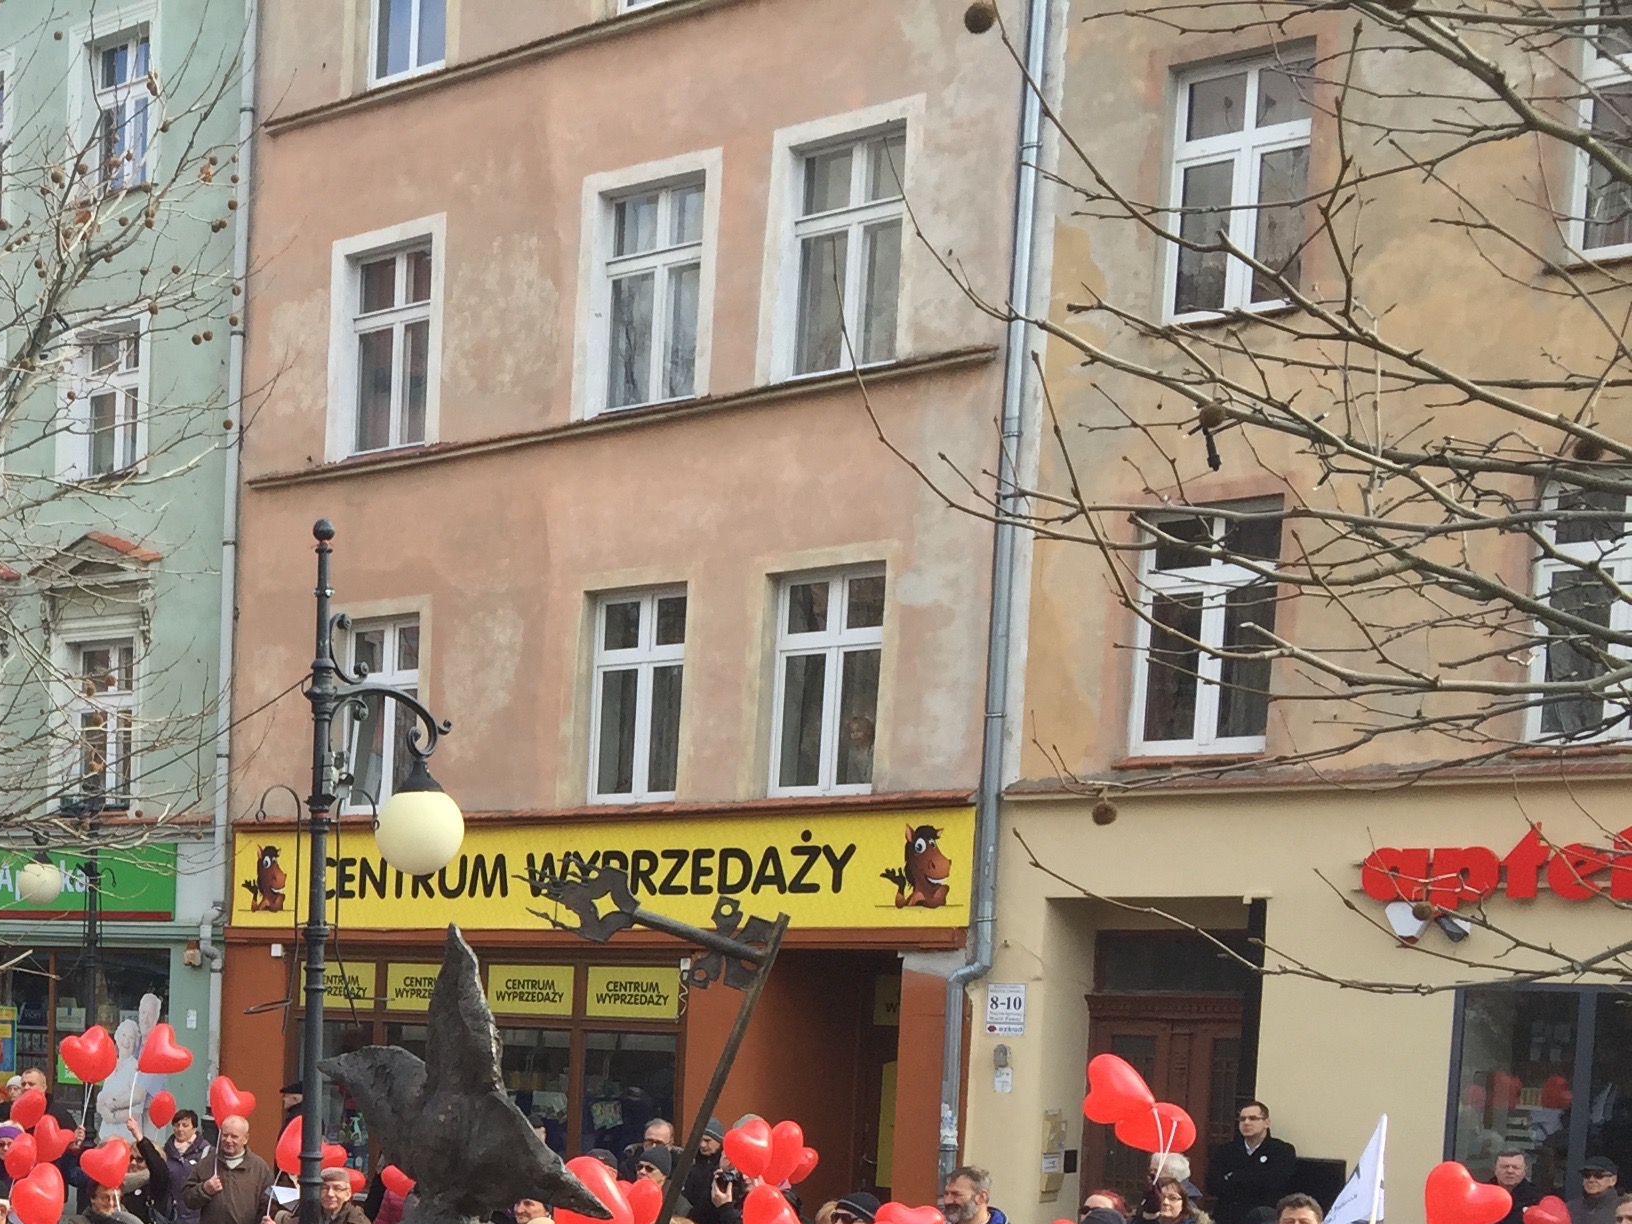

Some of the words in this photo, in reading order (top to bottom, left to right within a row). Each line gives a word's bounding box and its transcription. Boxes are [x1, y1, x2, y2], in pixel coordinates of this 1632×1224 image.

[322, 974, 360, 987] ENTRUM
[403, 976, 436, 988] CENTR
[505, 978, 556, 991] CENTRUM
[606, 980, 660, 994] CENTRUM
[394, 987, 434, 999] WYPRZE
[495, 990, 564, 1003] WYPRZEDAŻY
[596, 992, 670, 1006] WYPRZEDAŻY
[990, 995, 1022, 1011] 8-10
